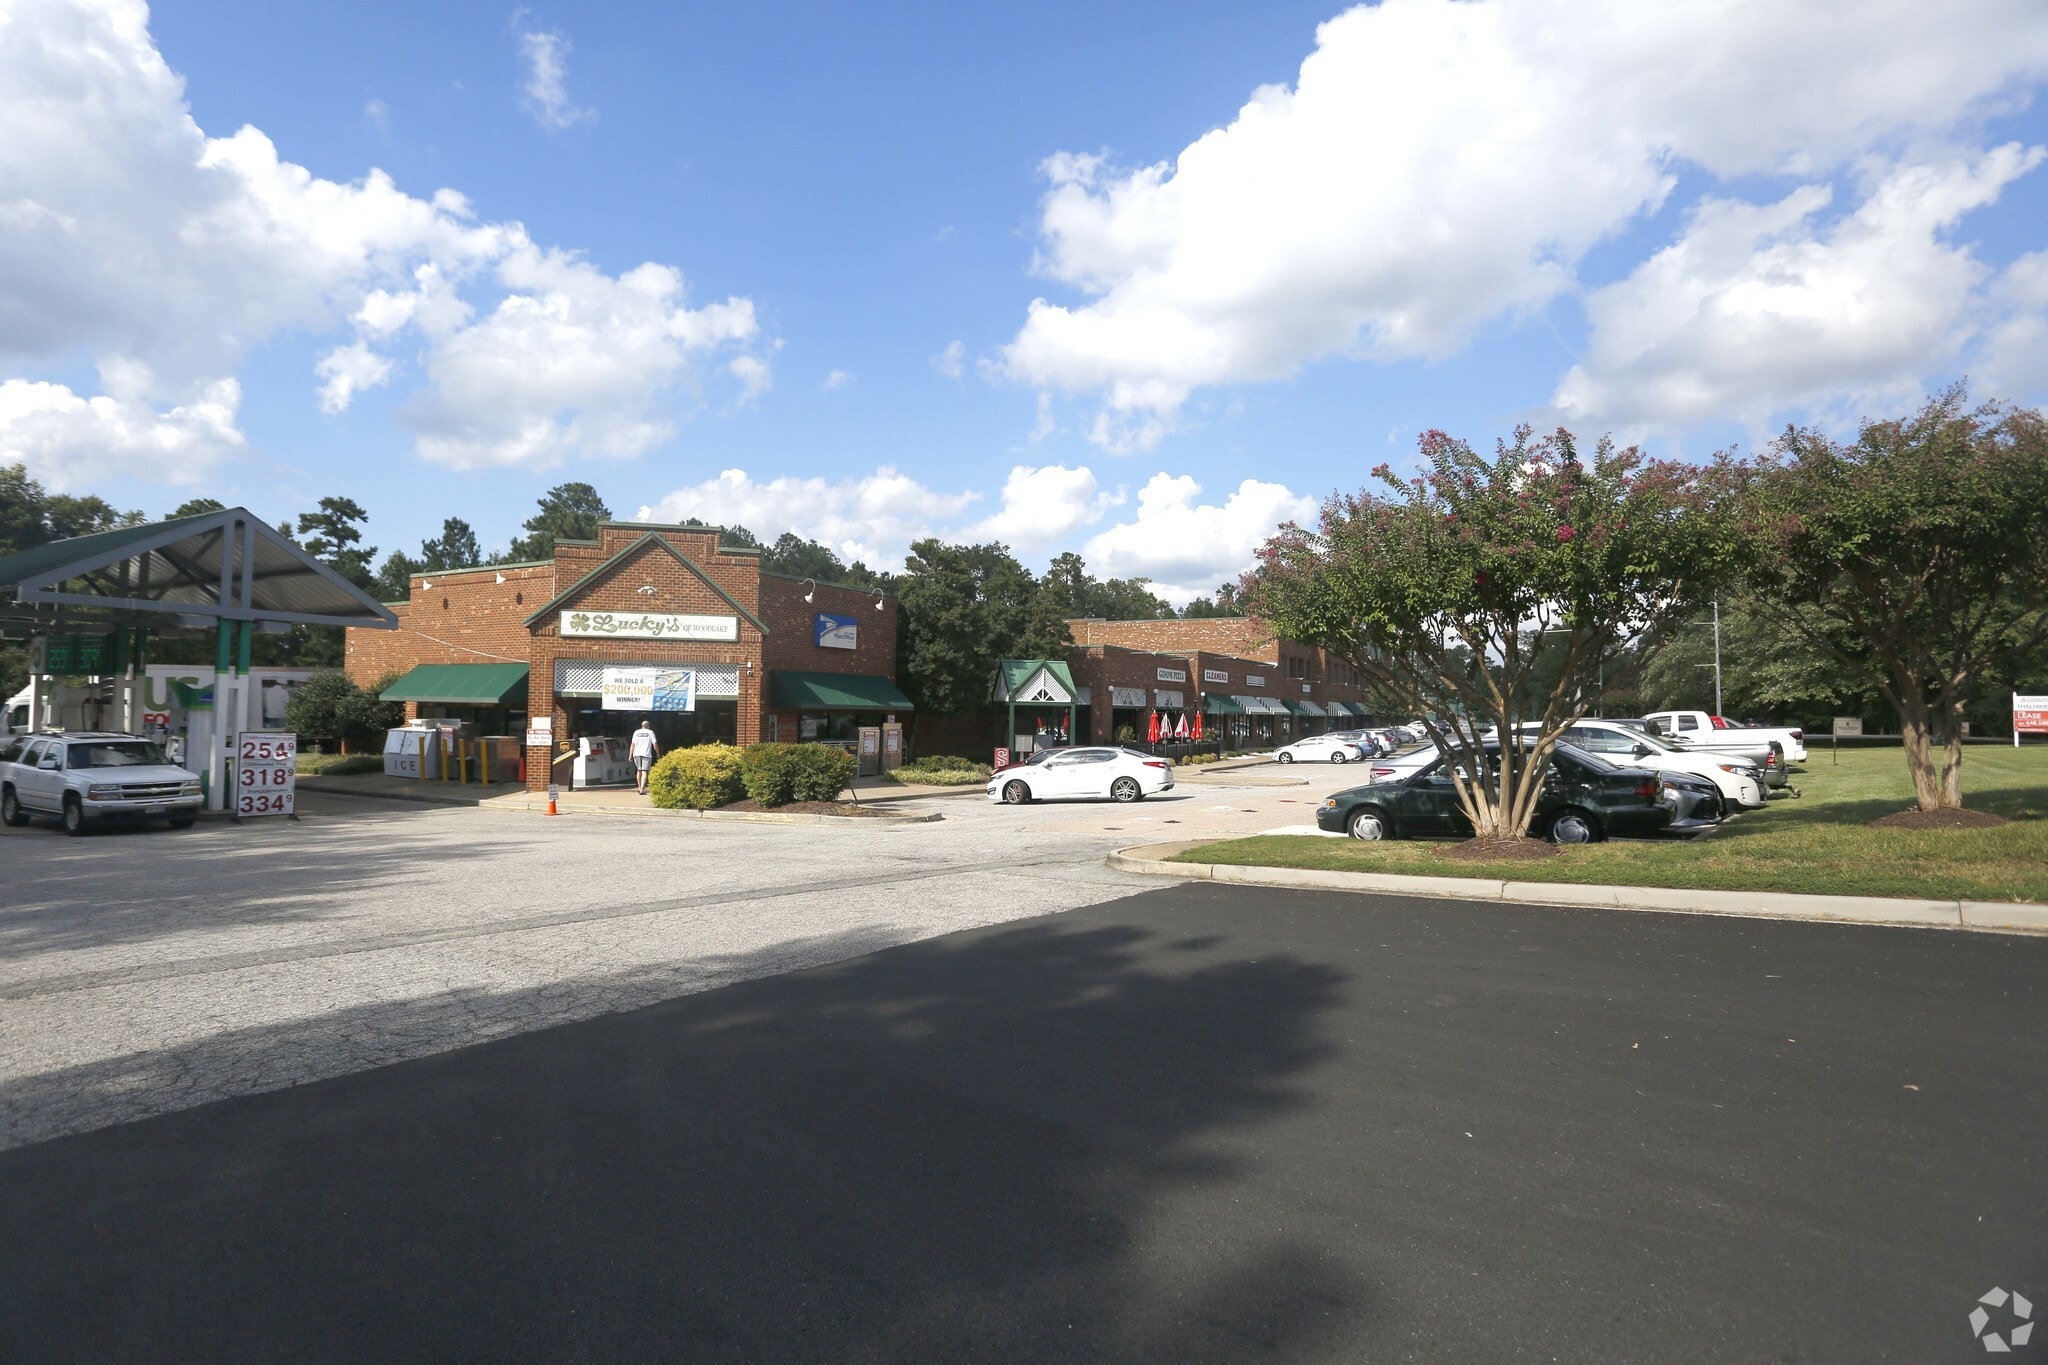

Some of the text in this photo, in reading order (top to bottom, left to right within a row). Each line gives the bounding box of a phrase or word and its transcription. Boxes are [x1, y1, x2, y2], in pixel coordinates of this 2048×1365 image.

[592, 614, 680, 636] Lucky's
[693, 624, 729, 633] WOODLAKE
[1206, 671, 1227, 682] CLEANERS
[603, 684, 654, 697] $200,000
[394, 760, 416, 771] ICE
